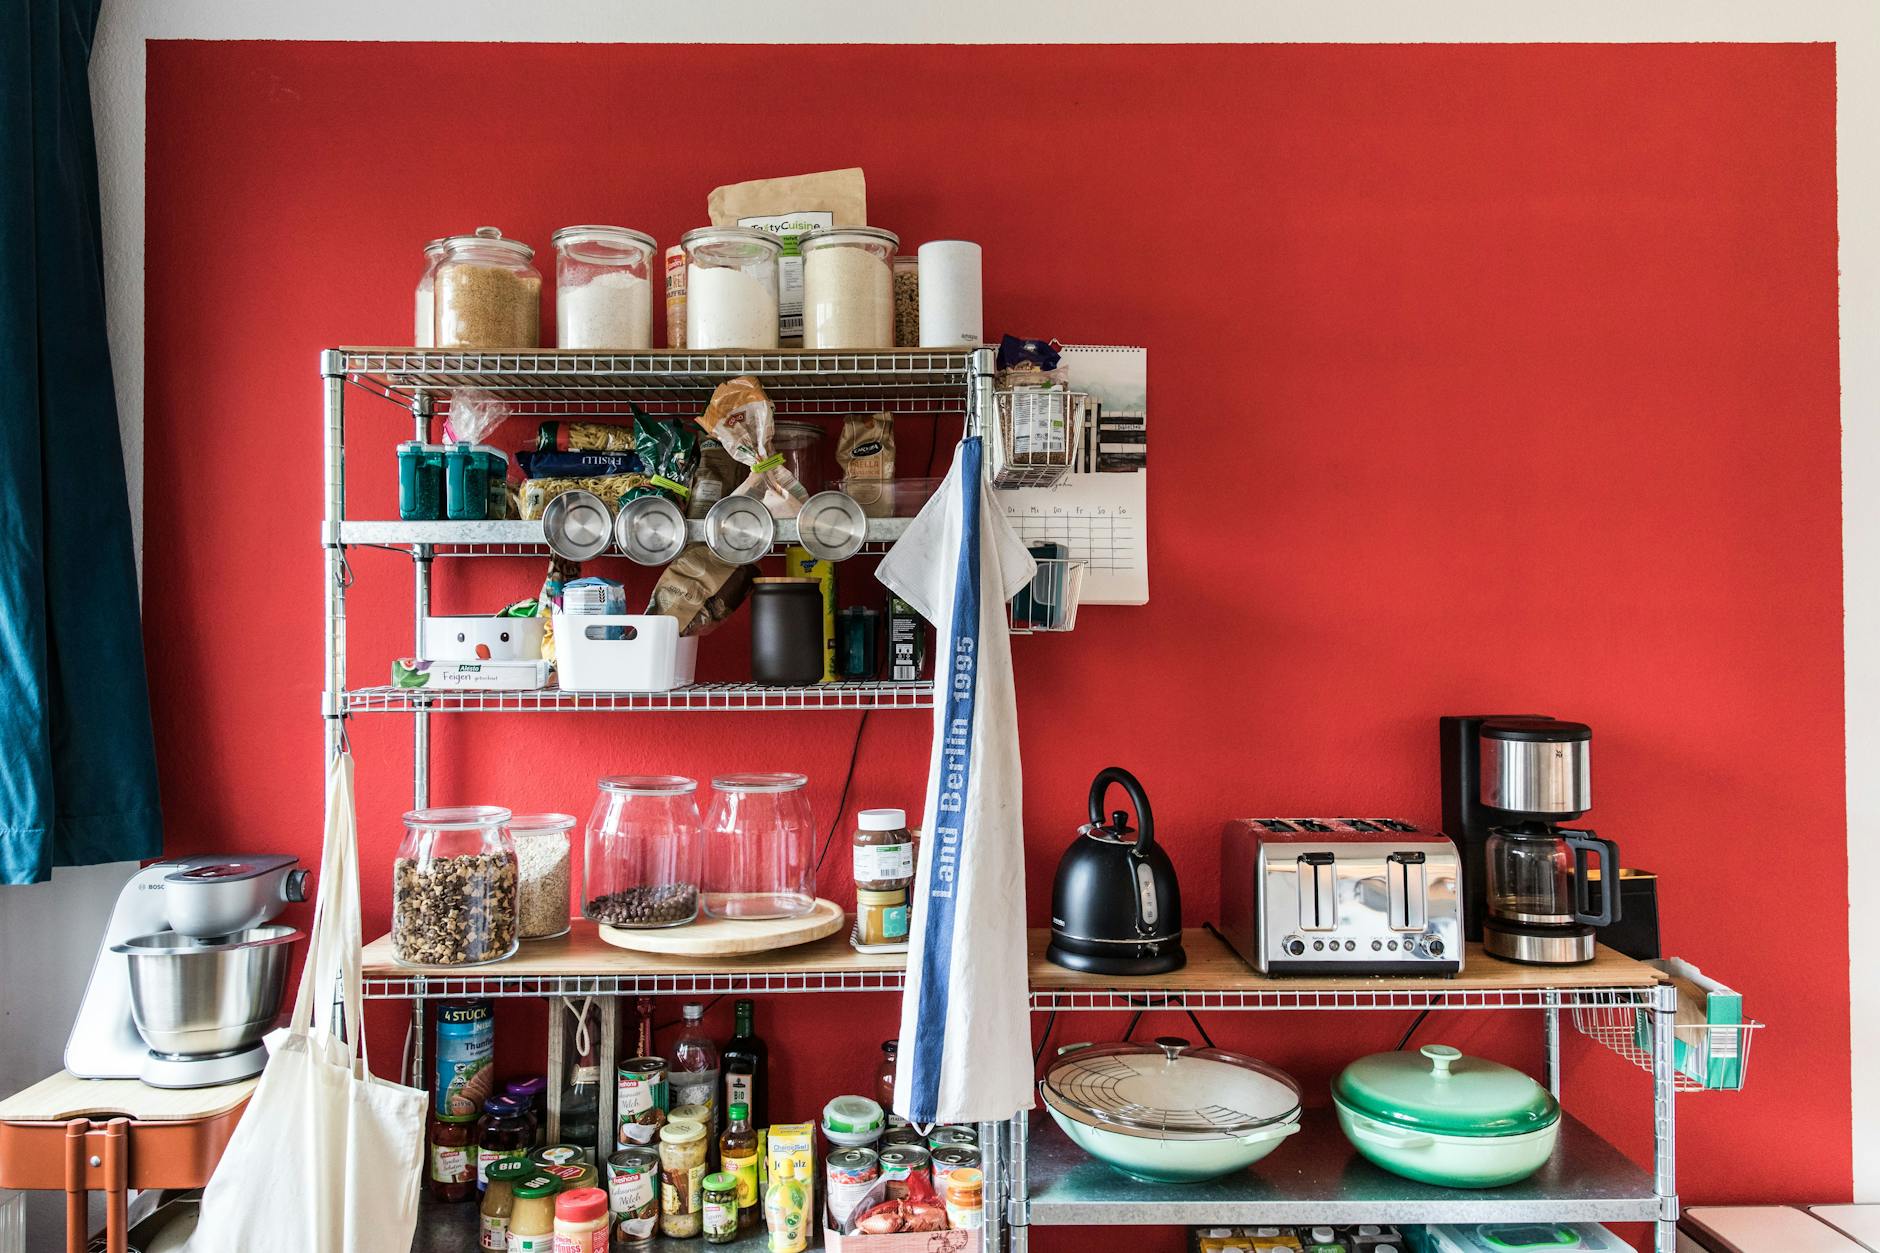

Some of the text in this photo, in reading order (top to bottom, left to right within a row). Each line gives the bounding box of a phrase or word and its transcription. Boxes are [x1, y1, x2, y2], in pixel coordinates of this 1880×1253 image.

[443, 671, 471, 684] Feigen
[932, 636, 975, 899] Land Berlin 1995
[444, 1007, 487, 1021] 4 STÜCK
[774, 1160, 806, 1171] Joalz
